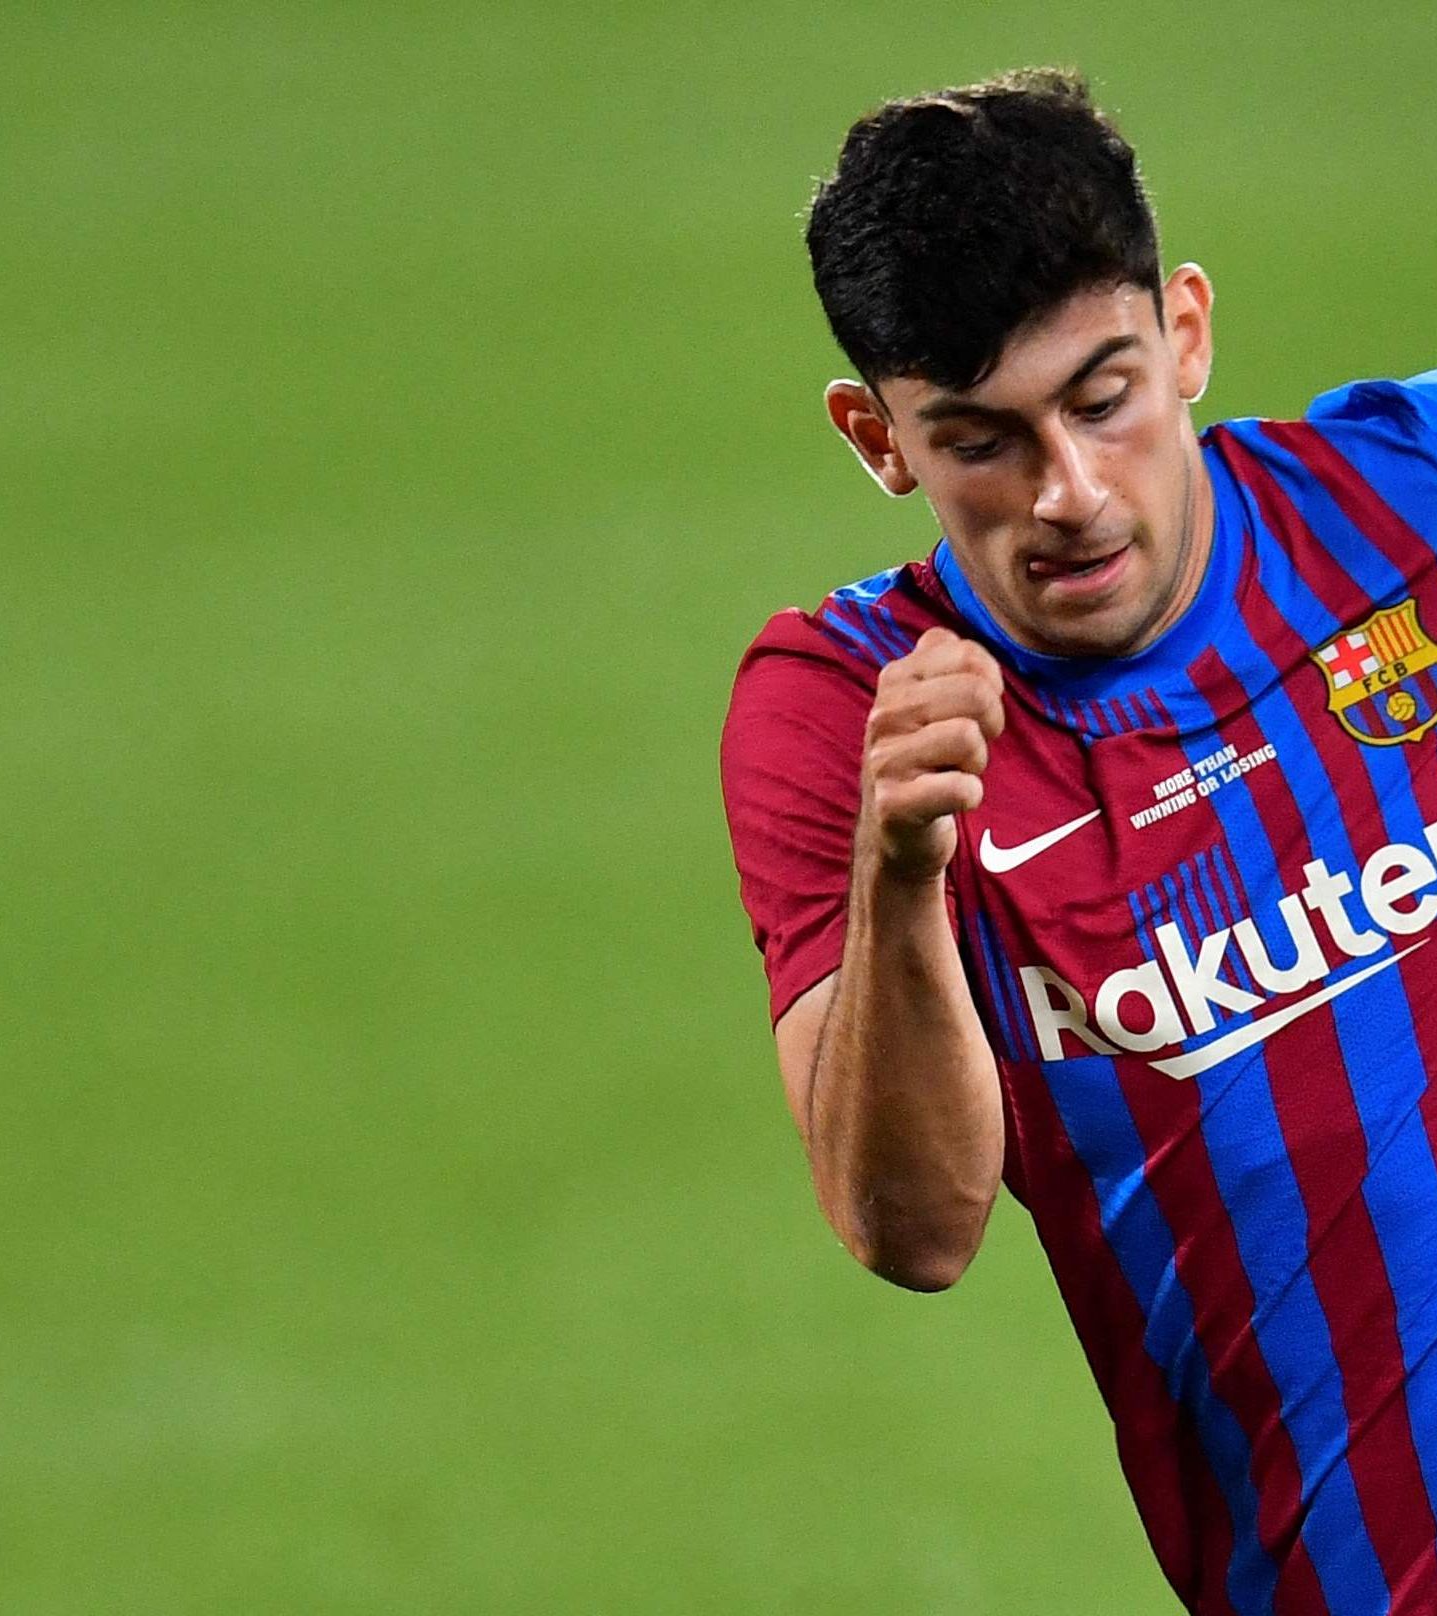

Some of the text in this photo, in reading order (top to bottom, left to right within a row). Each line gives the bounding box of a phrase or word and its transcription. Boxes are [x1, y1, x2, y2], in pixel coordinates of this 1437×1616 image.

[1362, 662, 1408, 694] FCB
[1129, 743, 1277, 830] WINNING OR LOSING
[1153, 743, 1239, 800] MORE THAN
